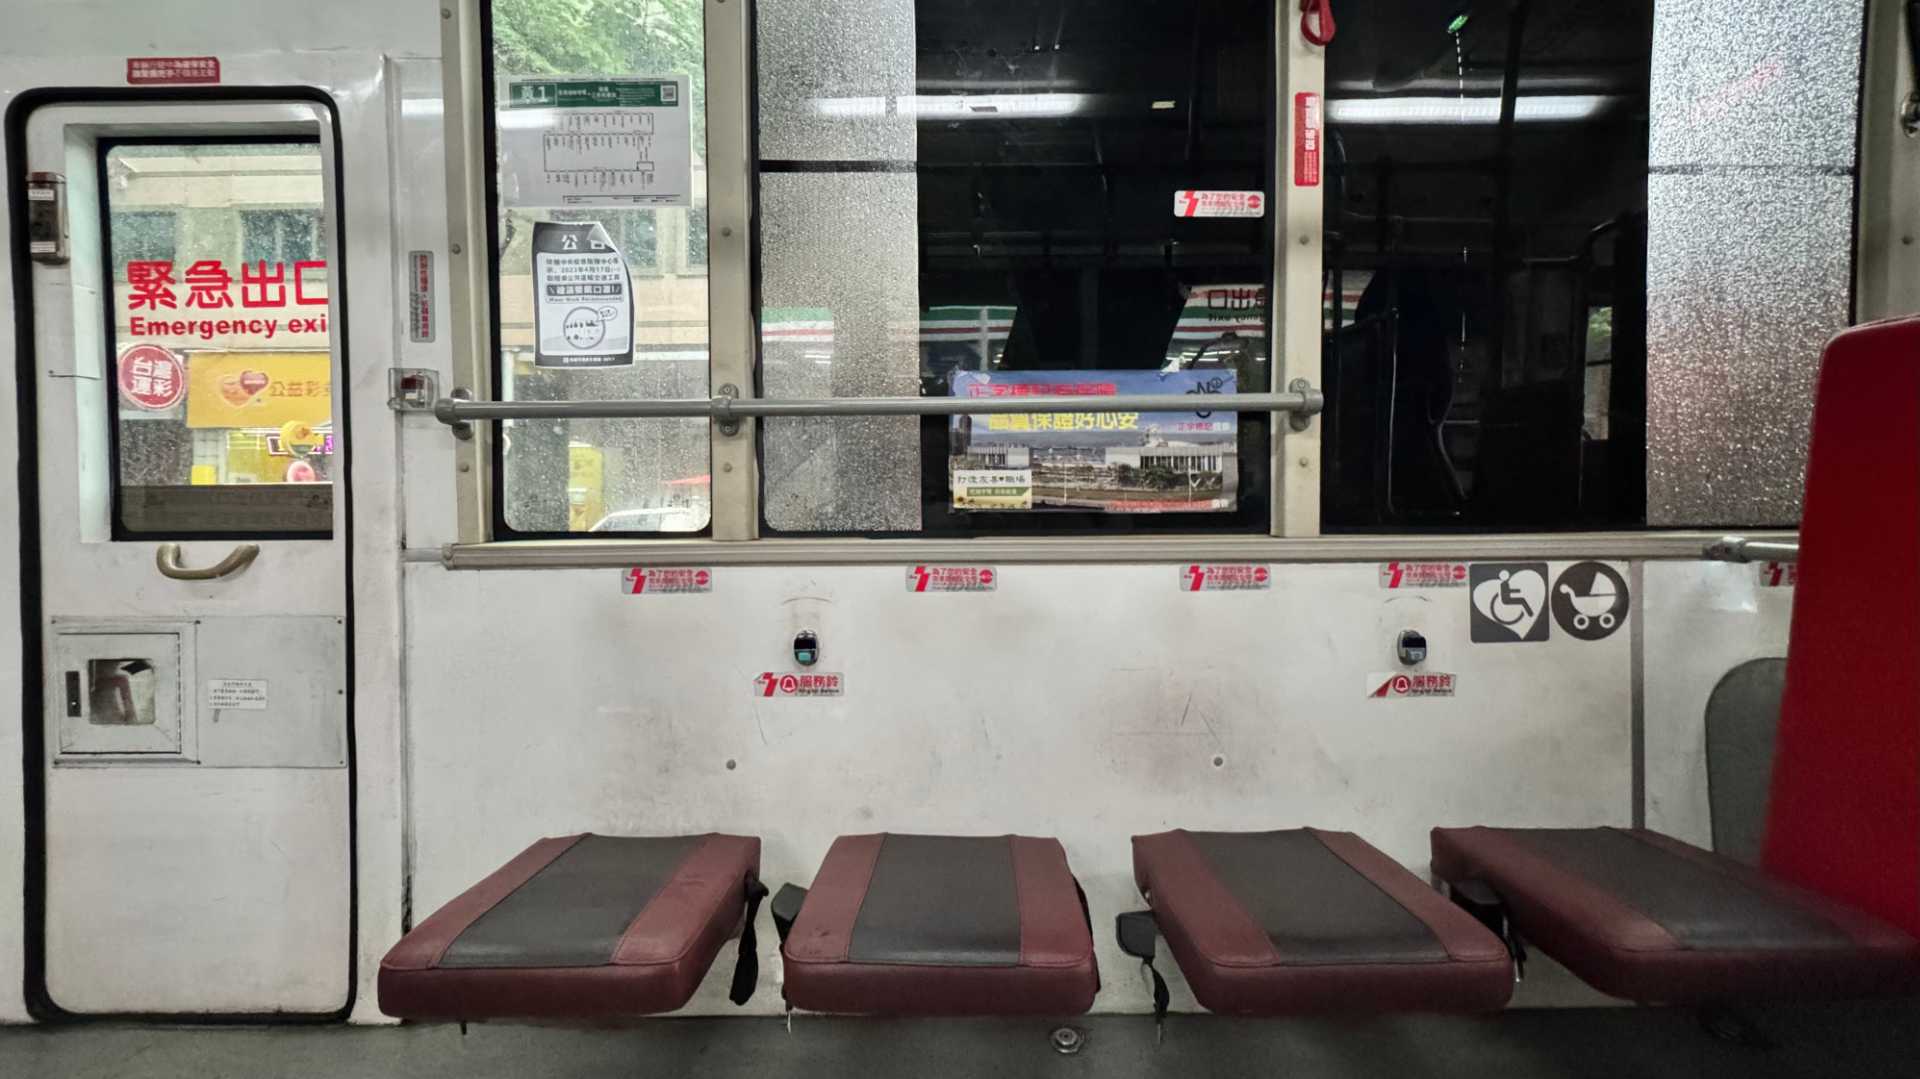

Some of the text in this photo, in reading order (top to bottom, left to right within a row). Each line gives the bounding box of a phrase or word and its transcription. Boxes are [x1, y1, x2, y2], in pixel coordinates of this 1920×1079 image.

[127, 259, 329, 311] 緊急出口
[130, 313, 328, 339] Emergency exi
[131, 356, 173, 380] 台灣
[131, 376, 173, 397] 運彩
[271, 381, 330, 397] 公益彩
[799, 675, 839, 688] 服務鈴
[1412, 674, 1452, 687] 服務鈴
